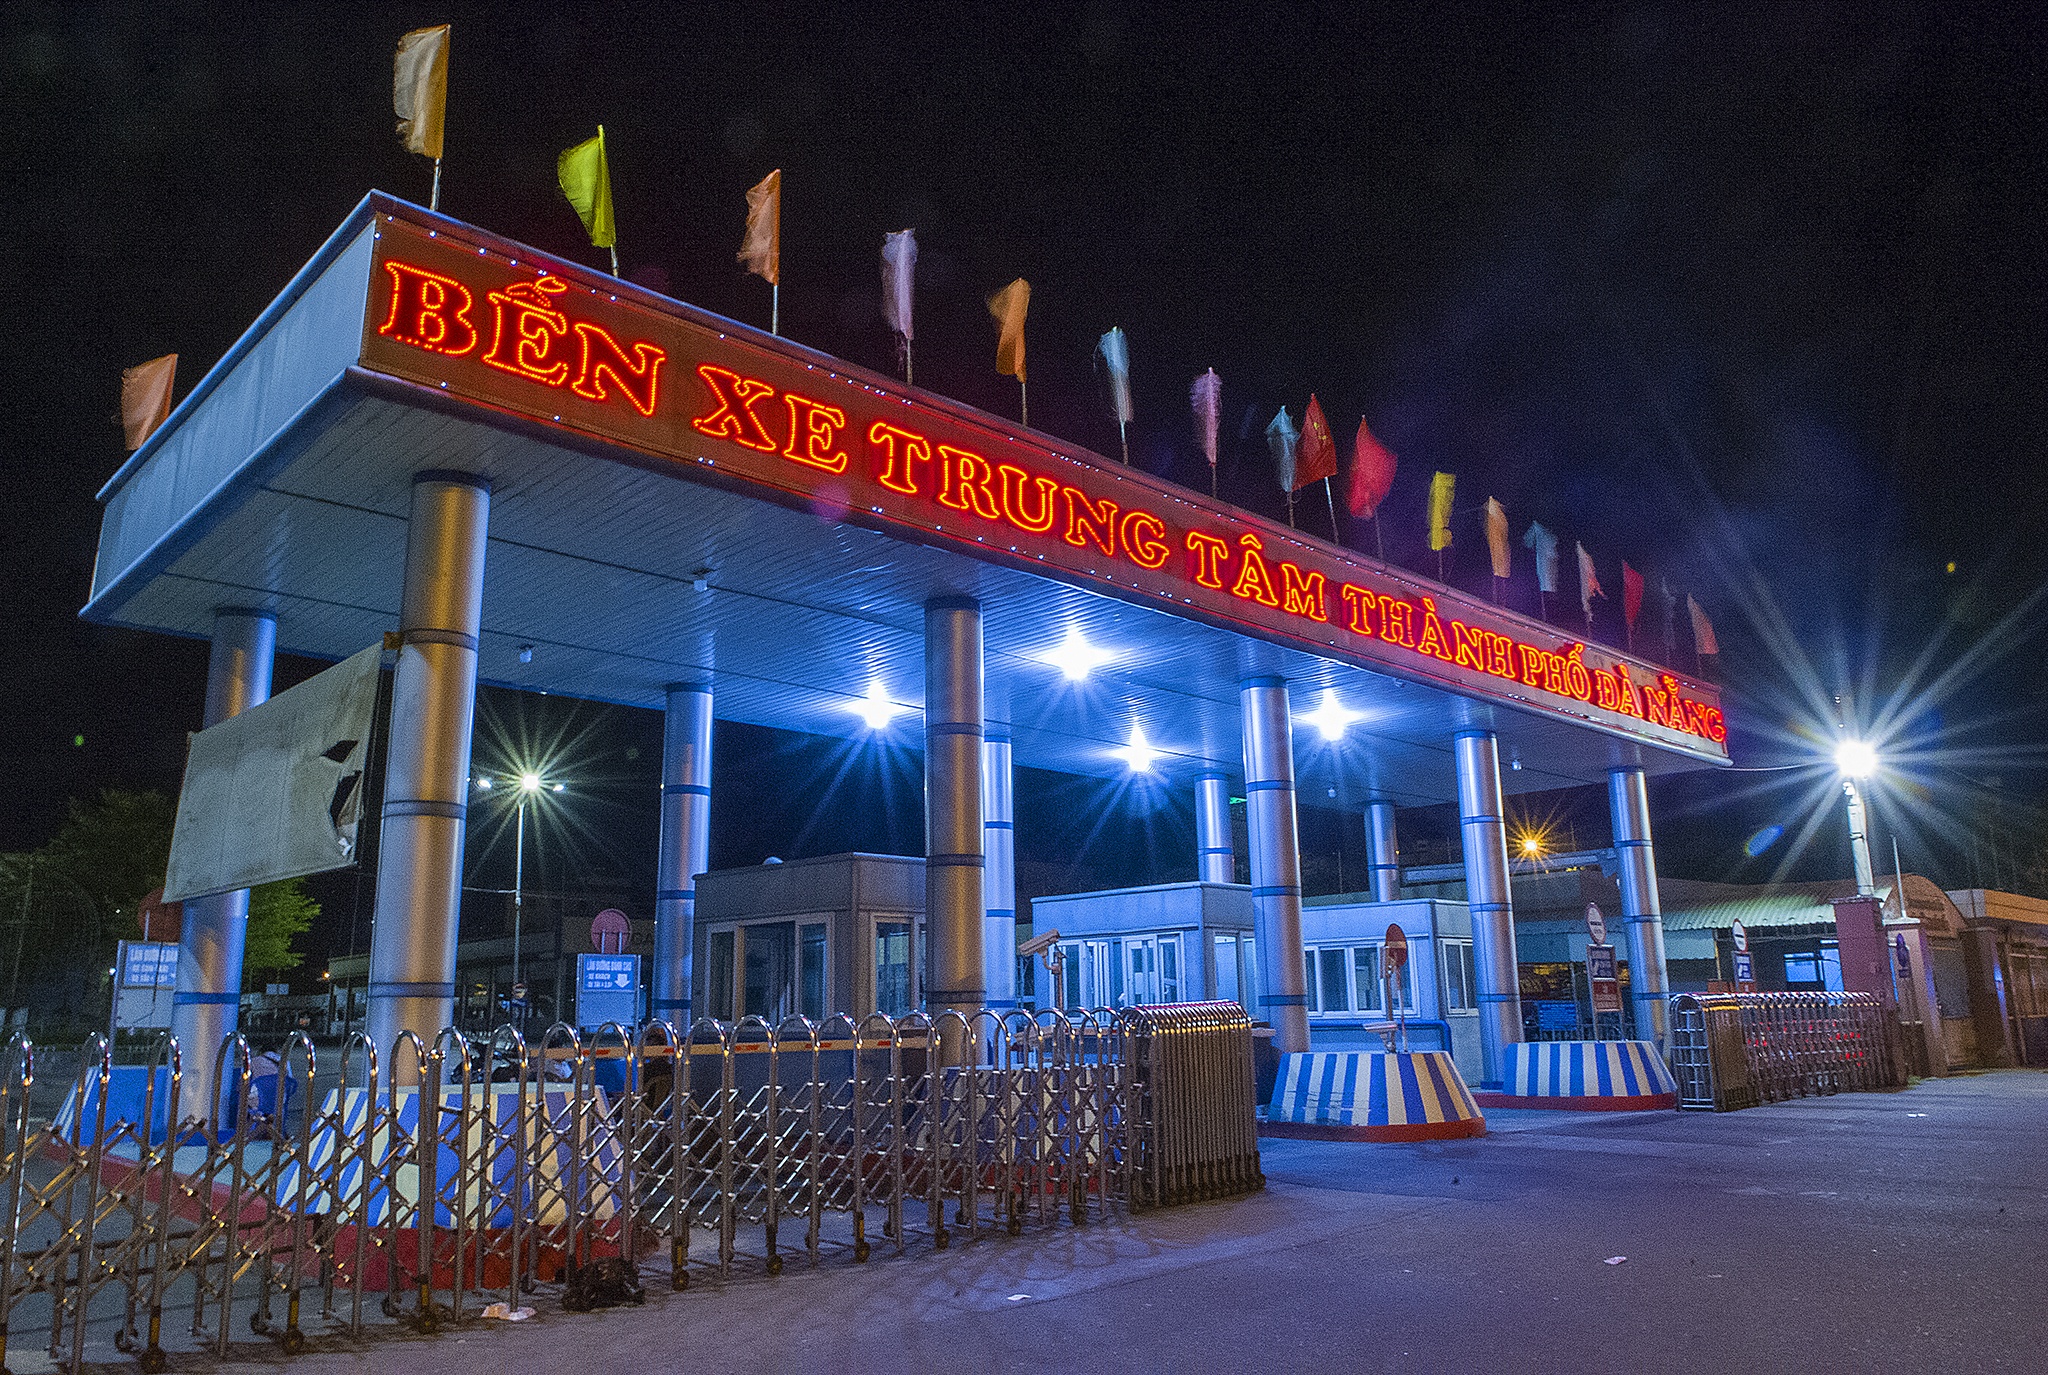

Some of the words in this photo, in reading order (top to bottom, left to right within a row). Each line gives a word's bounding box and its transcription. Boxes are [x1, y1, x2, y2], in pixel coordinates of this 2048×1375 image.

[379, 261, 665, 416] BẾN
[694, 366, 847, 473] XE
[869, 422, 1170, 568] TRUNG
[1187, 531, 1327, 621] TÂM
[1342, 583, 1516, 677] THÀNH
[1519, 643, 1591, 701] PHỐ
[1594, 663, 1643, 718] ĐÀ
